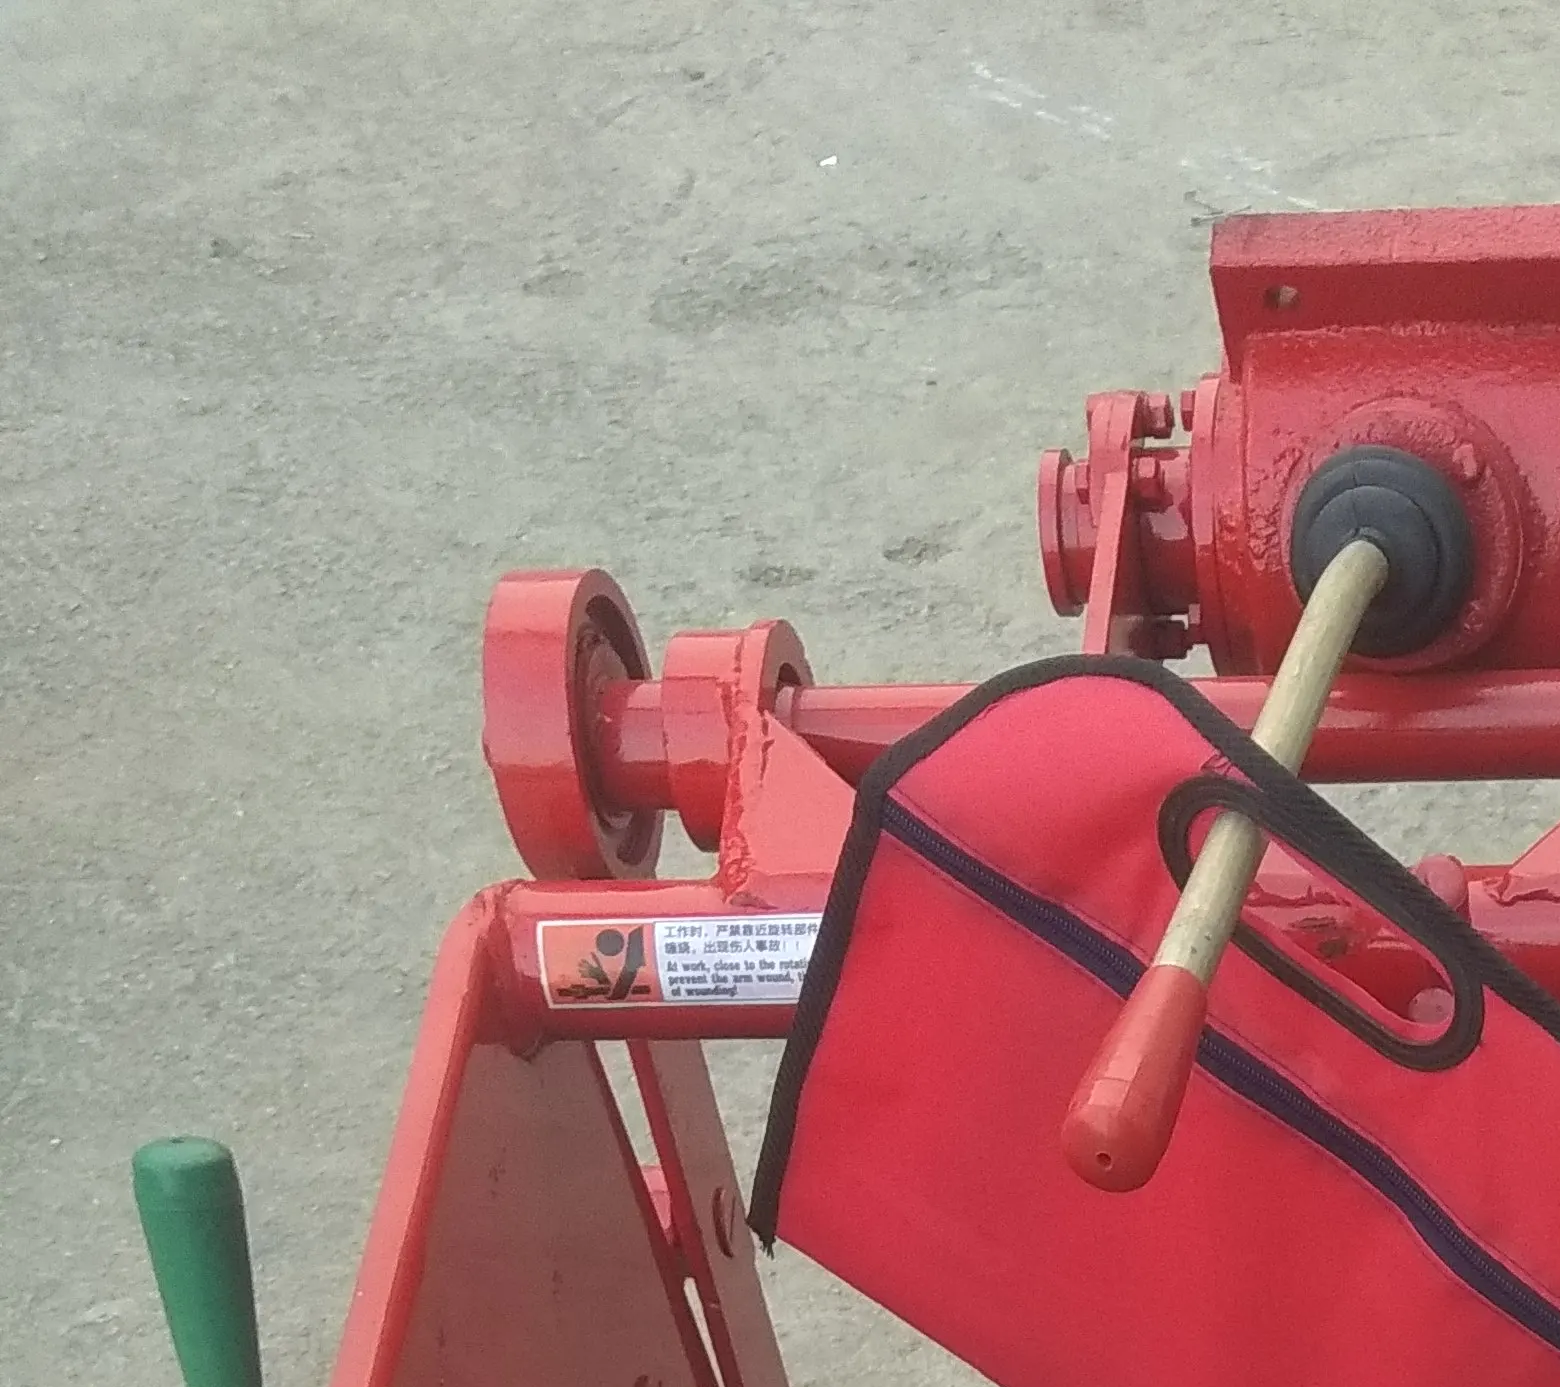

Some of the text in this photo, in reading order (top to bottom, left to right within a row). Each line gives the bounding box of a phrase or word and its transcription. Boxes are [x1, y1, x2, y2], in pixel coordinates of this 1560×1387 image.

[714, 959, 740, 971] close
[744, 960, 755, 970] to
[759, 959, 775, 969] the
[711, 973, 728, 983] the
